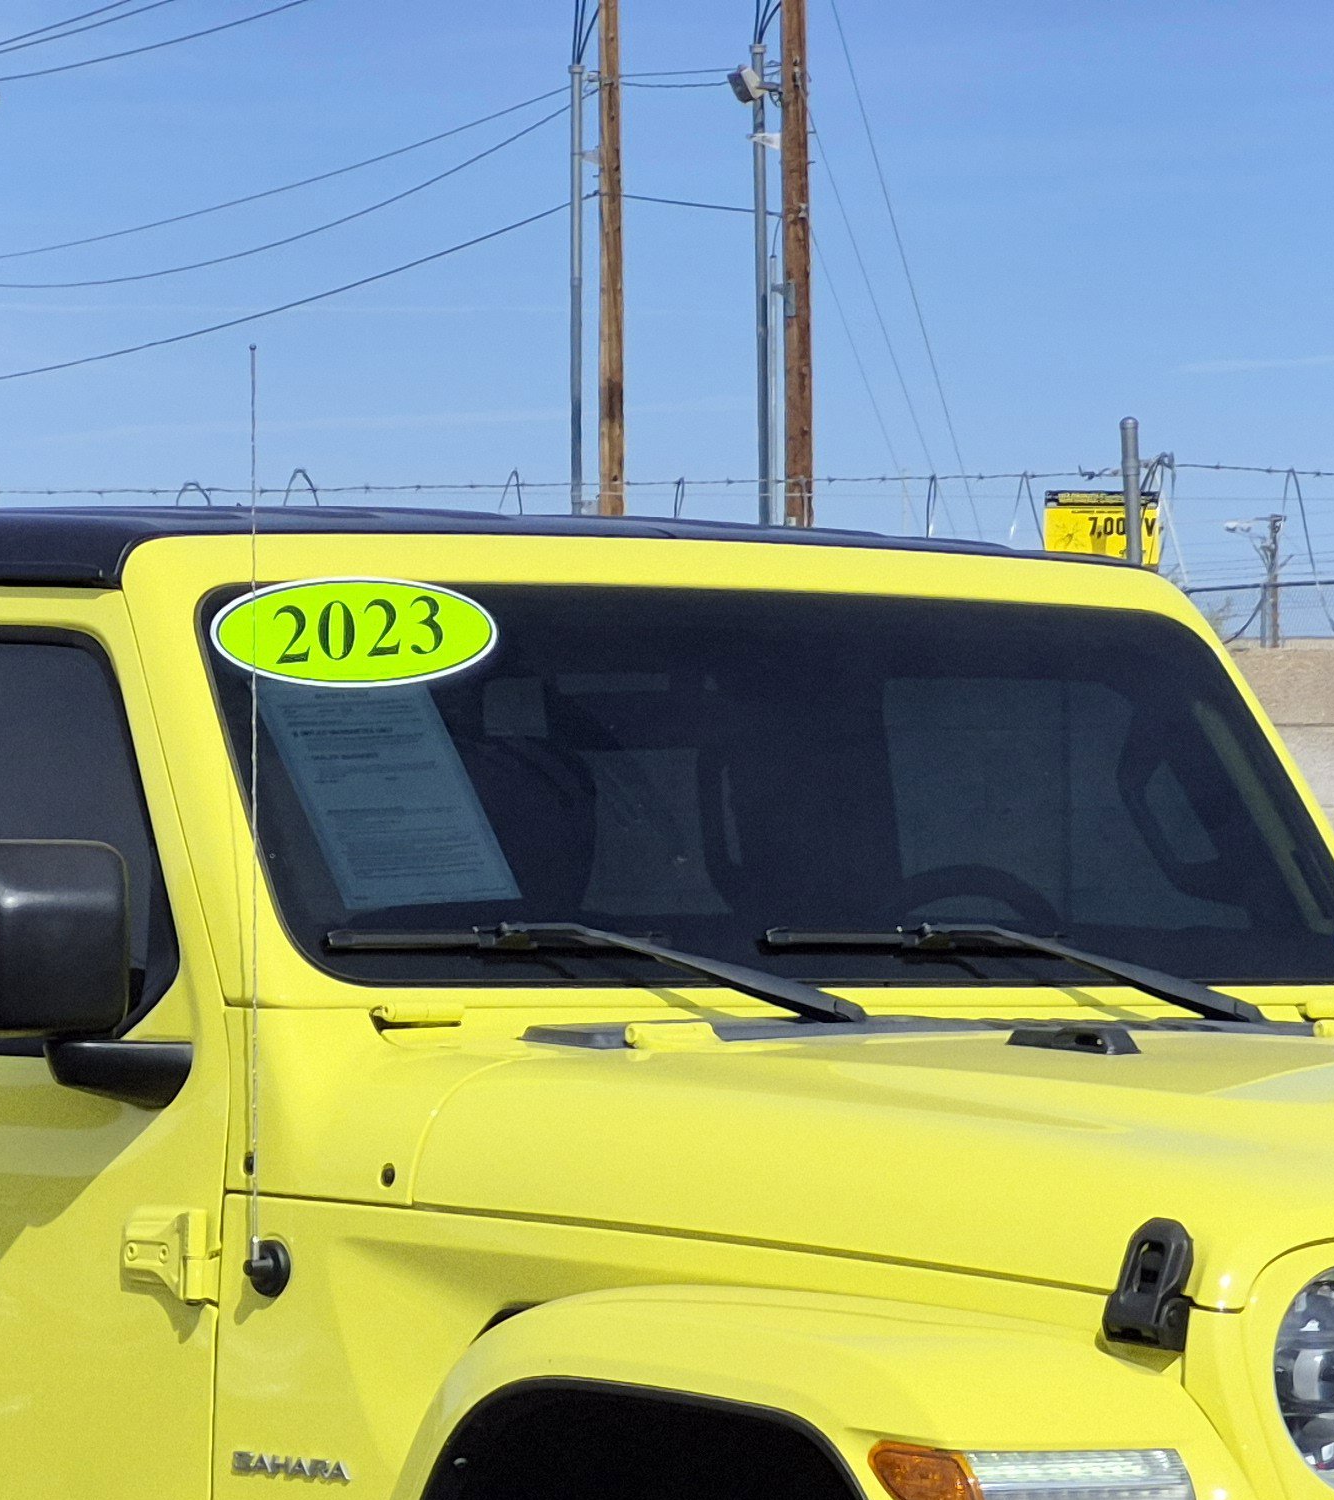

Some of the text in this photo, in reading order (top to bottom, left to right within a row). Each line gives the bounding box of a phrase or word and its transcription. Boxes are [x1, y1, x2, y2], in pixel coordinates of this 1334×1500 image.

[1088, 516, 1127, 539] 7,00
[273, 595, 444, 665] 2023
[232, 1450, 351, 1484] SAHARA
